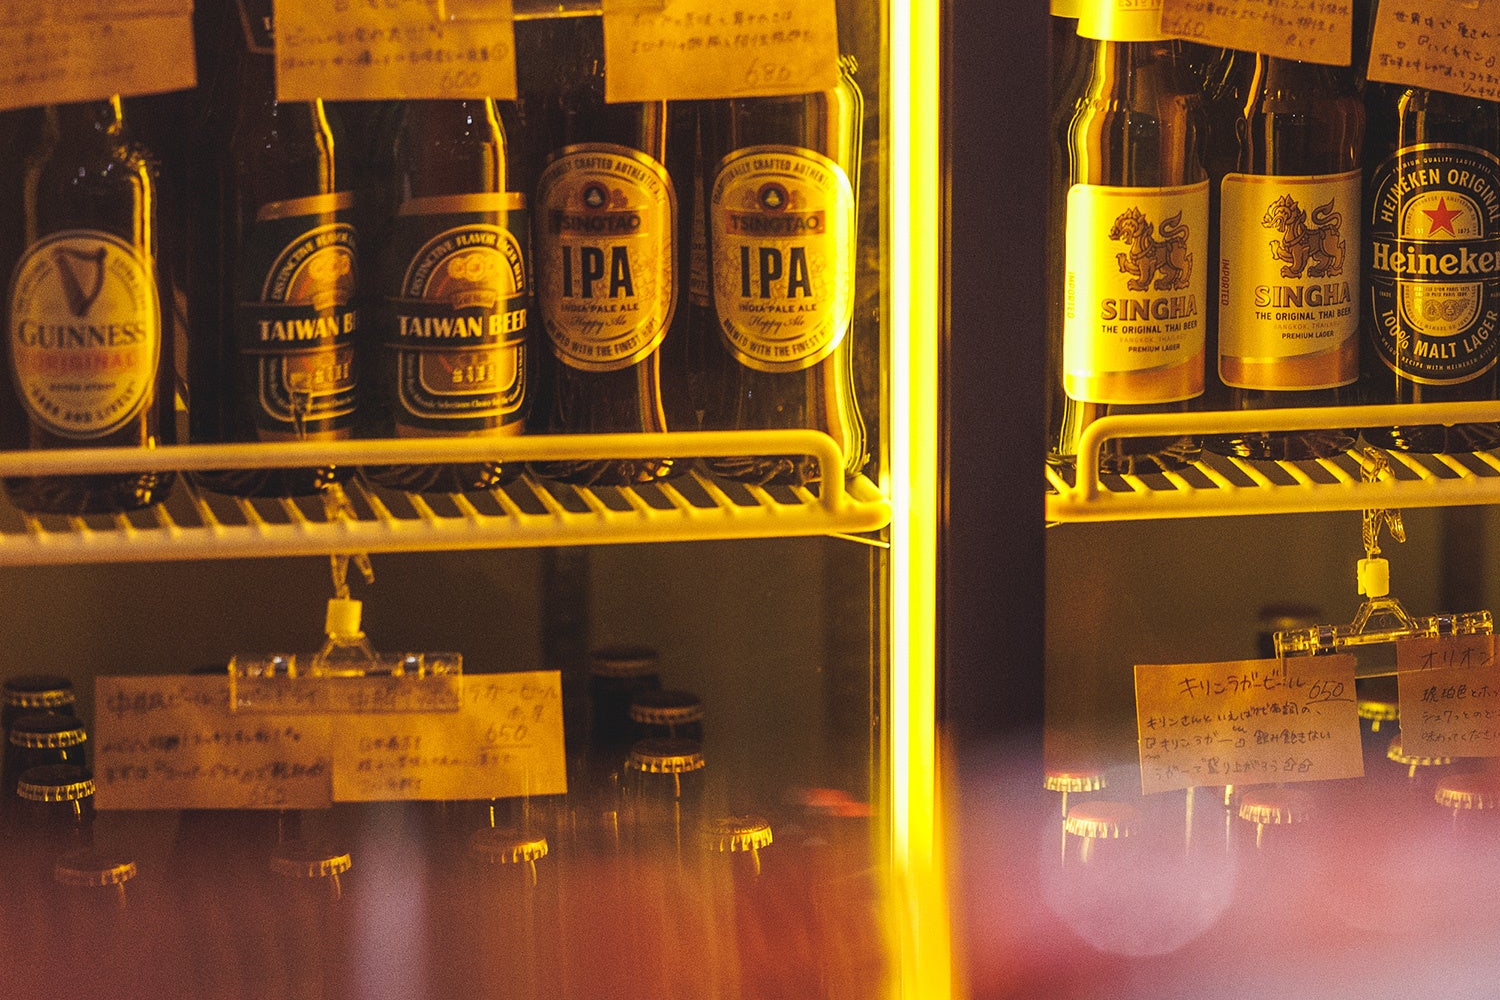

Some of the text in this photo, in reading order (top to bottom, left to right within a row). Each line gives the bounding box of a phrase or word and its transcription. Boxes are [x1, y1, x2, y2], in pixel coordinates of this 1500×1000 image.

[1381, 168, 1441, 224] HEINEKEN
[1447, 168, 1500, 224] ORIGINAL
[730, 213, 820, 230] TSINGTAO
[561, 245, 634, 299] IPA
[740, 245, 812, 299] IPA
[1221, 259, 1230, 307] IMPORTED
[1067, 271, 1075, 319] IMPORTED
[1254, 281, 1352, 308] SINGHA
[619, 303, 639, 312] ALE
[768, 304, 795, 313] PALE
[797, 303, 818, 312] ALE
[1101, 294, 1198, 321] SINGHA
[1255, 307, 1352, 321] THE ORIGINAL THAI BEER
[17, 318, 148, 349] GUINNESS
[258, 318, 339, 342] TAIWAN
[398, 314, 483, 338] TAIWAN
[1102, 320, 1198, 334] THE ORIGINAL THAI BEER
[1315, 330, 1335, 338] LAGER
[1382, 309, 1411, 351] 100%
[1413, 340, 1457, 360] MALT
[1463, 309, 1498, 355] LAGER
[595, 345, 612, 356] THE
[748, 344, 771, 357] WITH
[773, 346, 791, 357] THE
[1128, 343, 1181, 353] PREMIUM LAGER
[1178, 669, 1306, 699] キリンラガービール
[1309, 679, 1344, 700] 650
